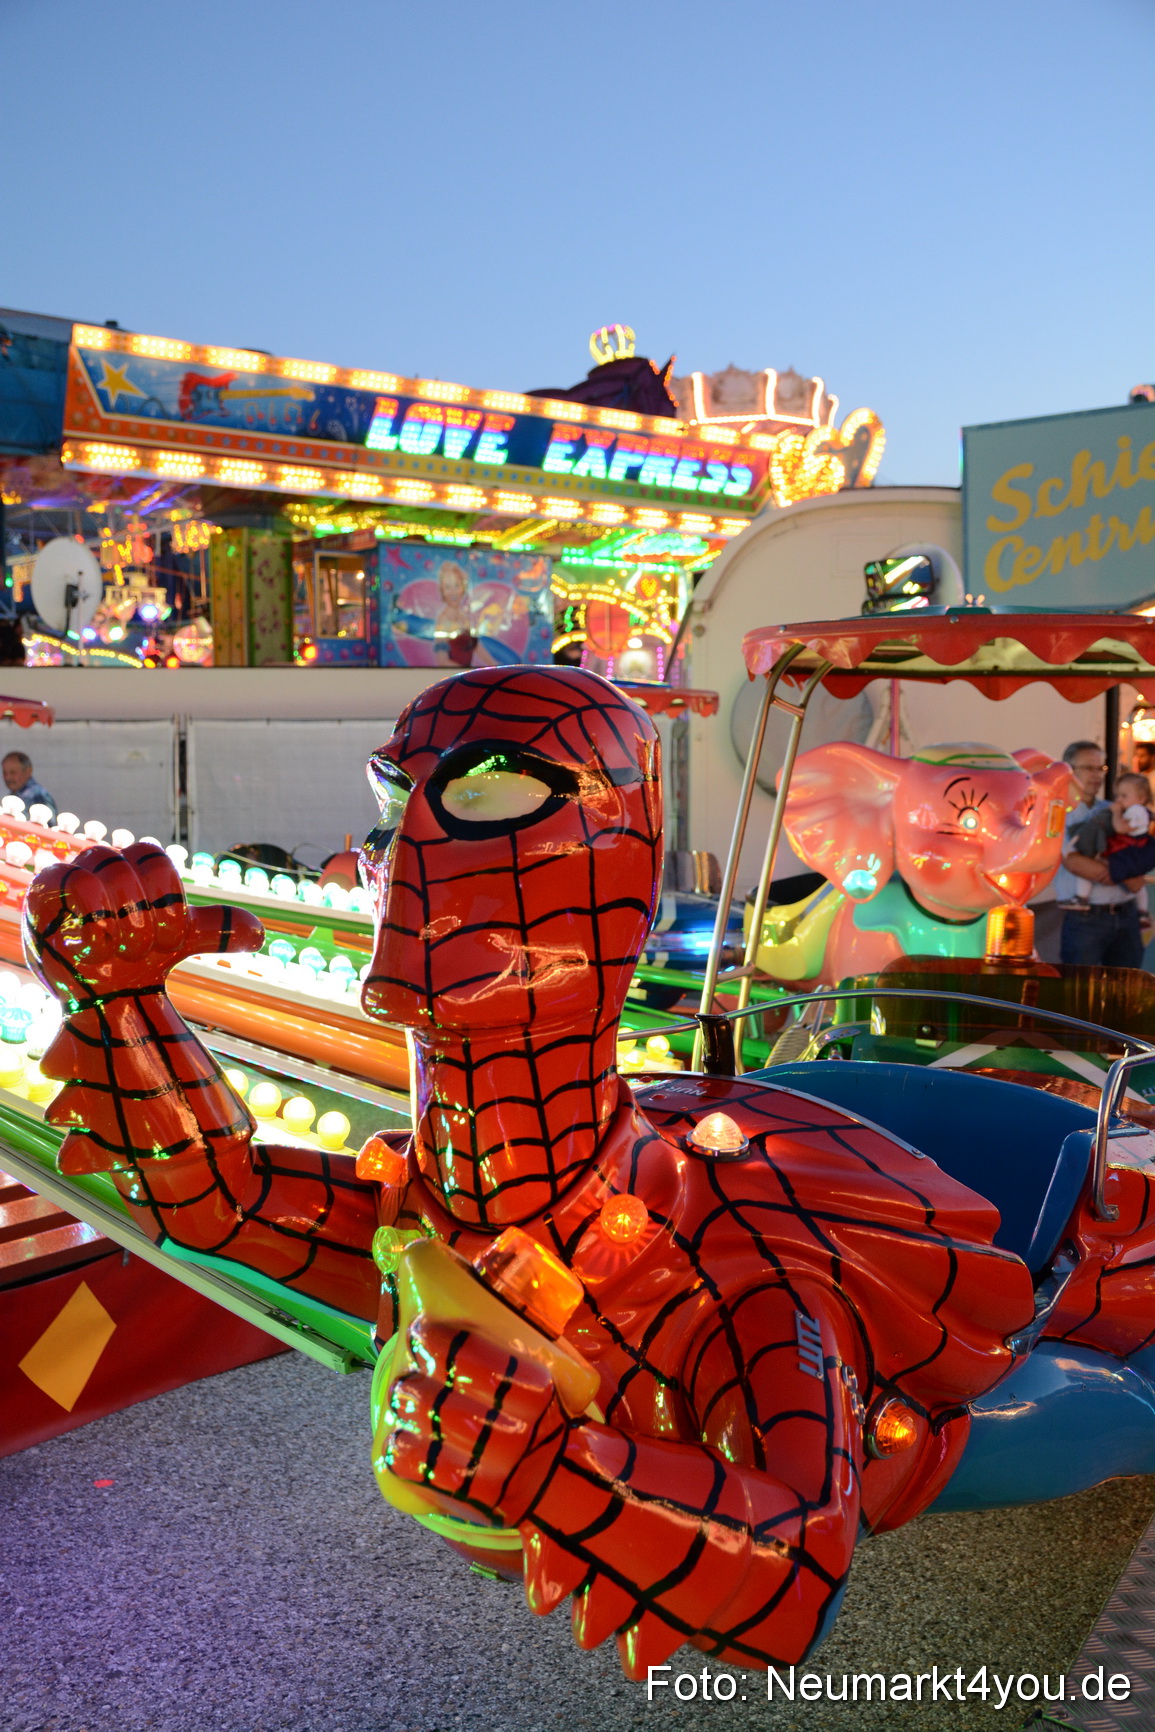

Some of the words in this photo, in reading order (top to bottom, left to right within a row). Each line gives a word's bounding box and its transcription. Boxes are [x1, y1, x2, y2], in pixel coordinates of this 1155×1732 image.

[365, 397, 516, 465] LOVE
[542, 423, 754, 496] EXPRESS
[985, 434, 1155, 533] Schie
[794, 1309, 825, 1383] LUTZ
